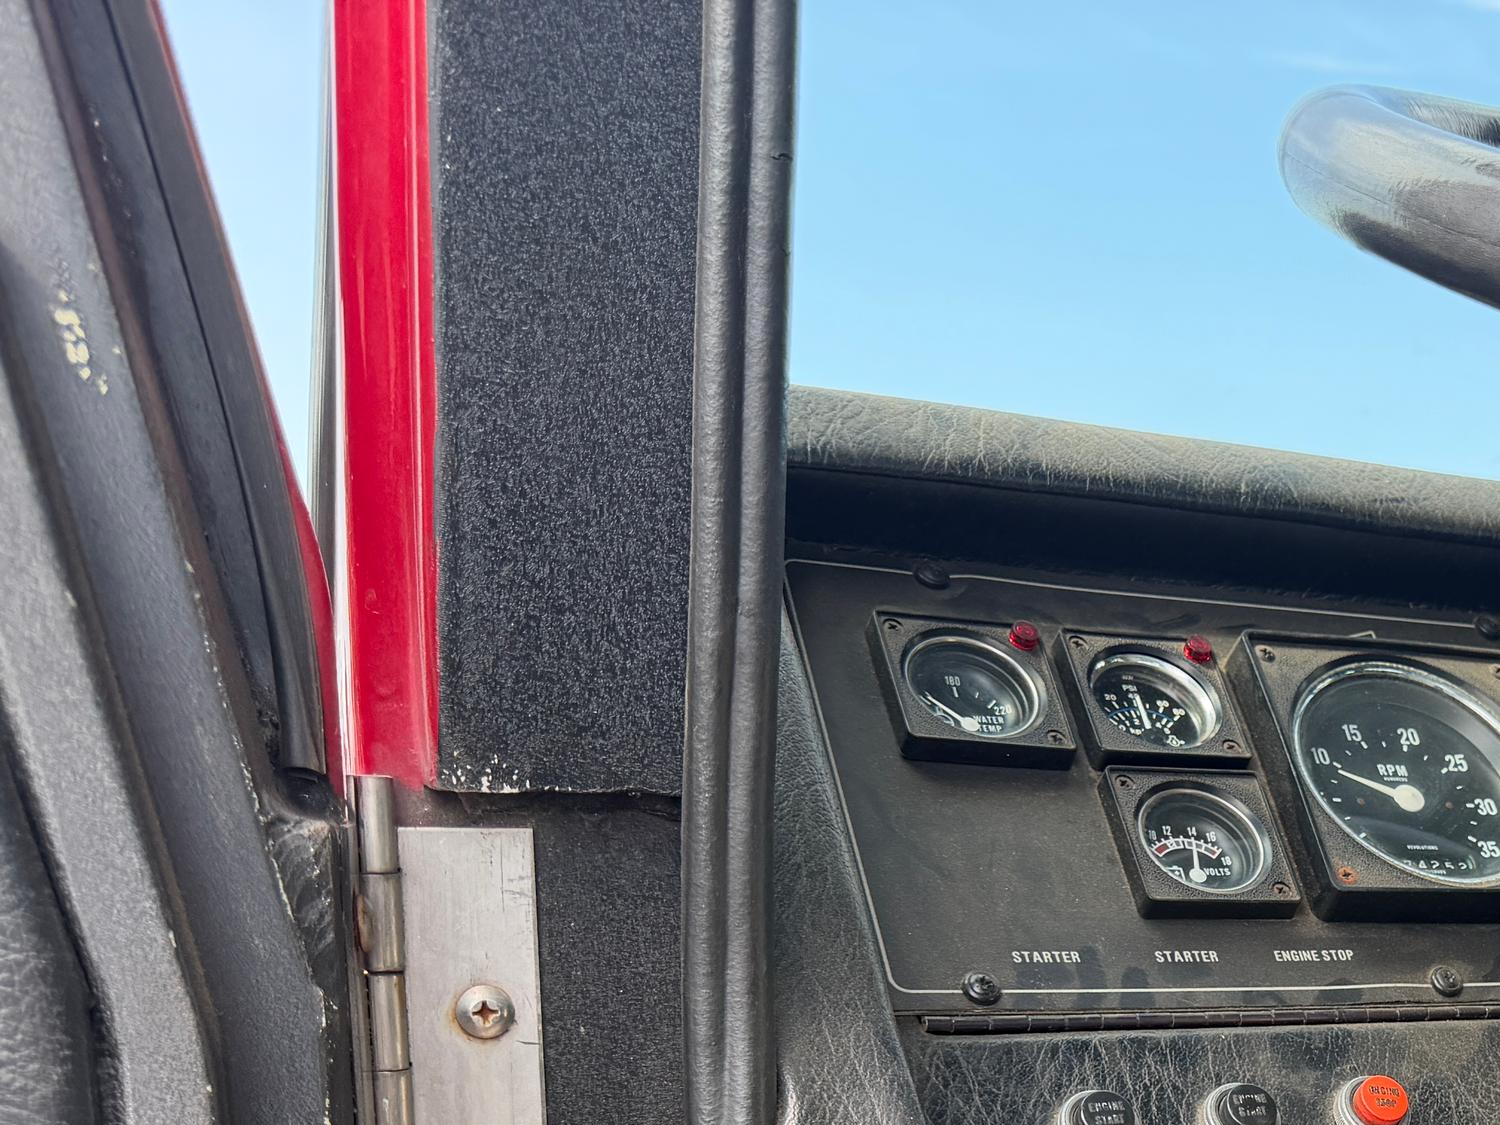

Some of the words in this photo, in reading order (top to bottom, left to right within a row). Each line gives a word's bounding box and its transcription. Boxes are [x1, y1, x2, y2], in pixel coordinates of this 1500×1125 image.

[1341, 724, 1362, 741] 15
[1397, 727, 1420, 746] 20
[1310, 747, 1331, 765] 10
[1444, 754, 1469, 772] 25
[1377, 764, 1409, 777] RPM
[1474, 798, 1498, 816] 30
[1162, 825, 1173, 836] 12
[1187, 826, 1198, 837] 14
[1205, 831, 1217, 842] 16
[1477, 840, 1500, 858] 35
[1221, 856, 1233, 866] 18
[1204, 868, 1231, 876] VOLTS
[1012, 951, 1081, 963] STARTER
[1154, 950, 1219, 963] STARTER
[1273, 950, 1320, 962] ENGINE
[1322, 949, 1354, 961] STOP
